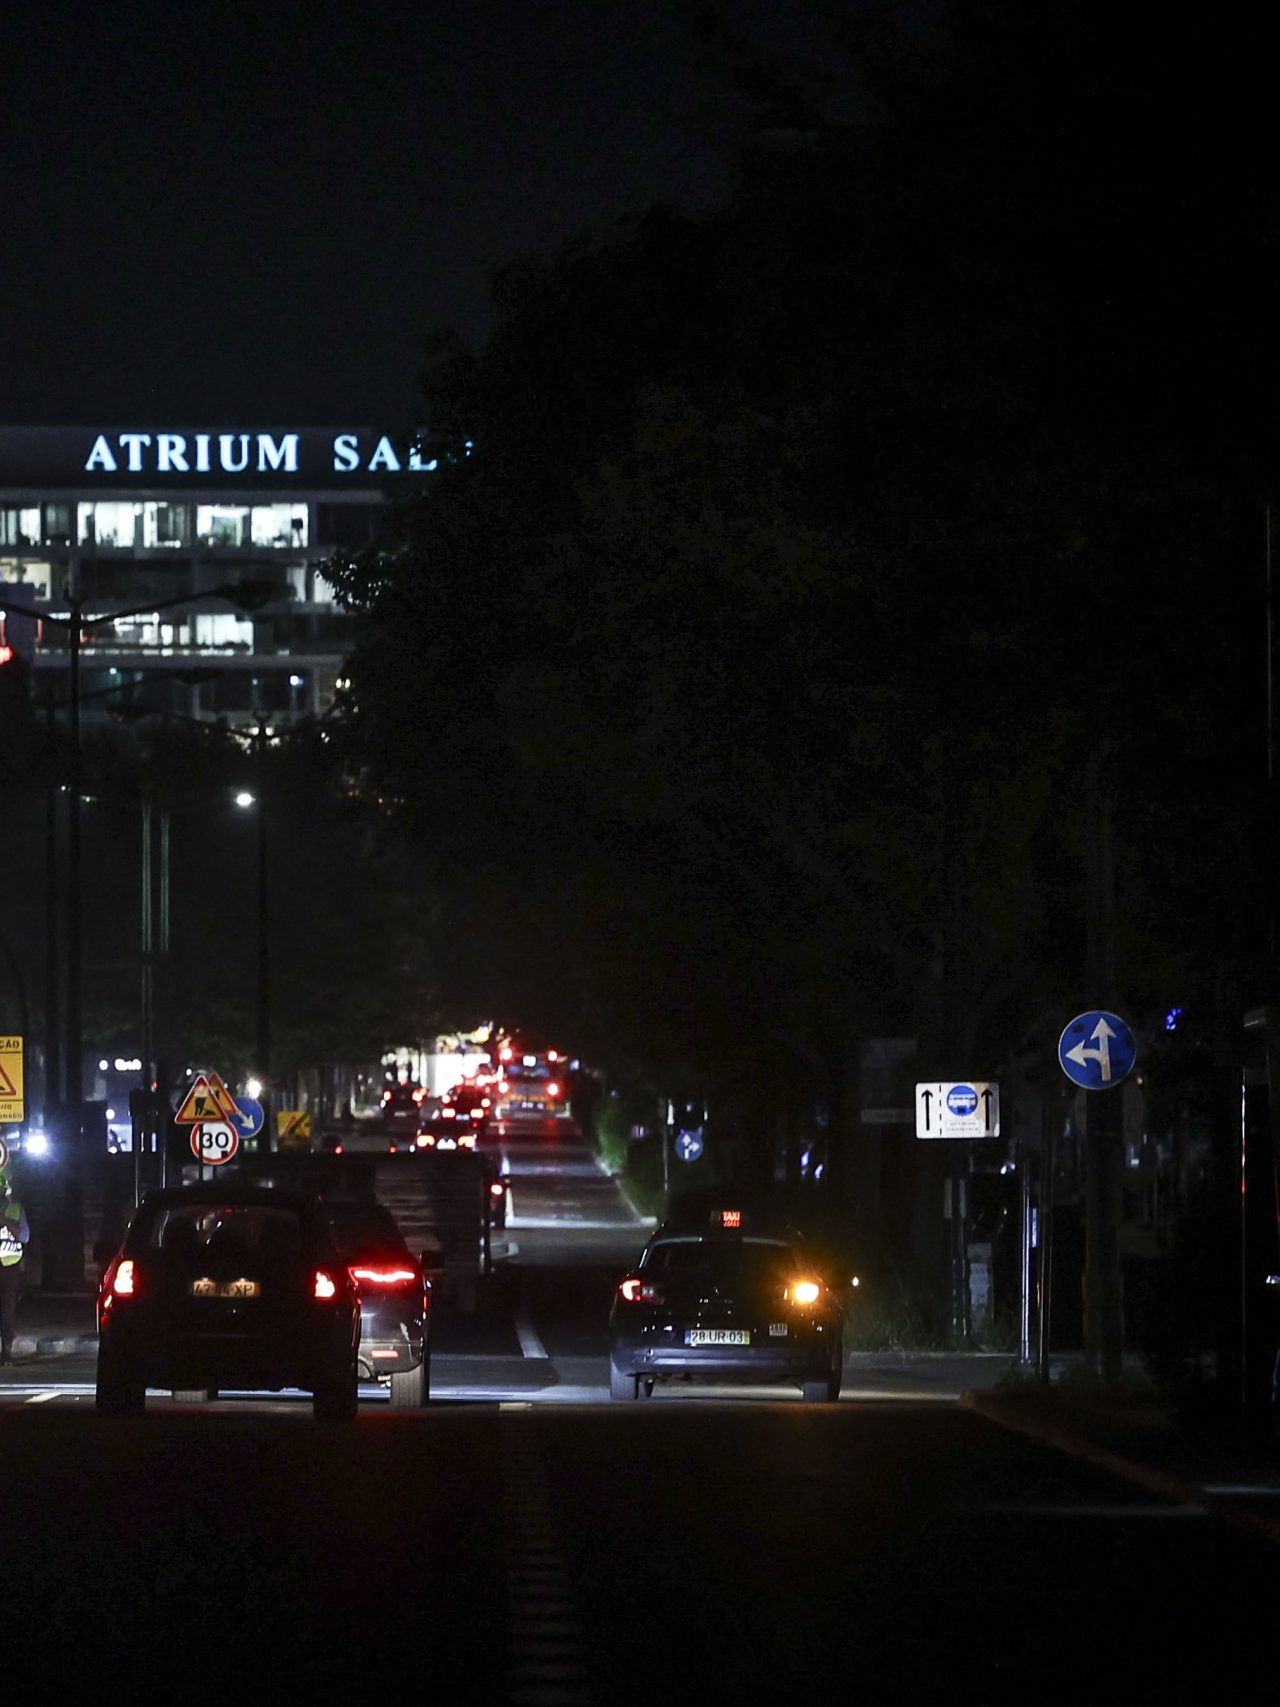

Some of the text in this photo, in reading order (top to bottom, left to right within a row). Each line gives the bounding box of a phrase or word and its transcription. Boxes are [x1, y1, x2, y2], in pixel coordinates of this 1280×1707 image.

[85, 434, 473, 472] ATRIUM SAL
[202, 1131, 229, 1149] 30
